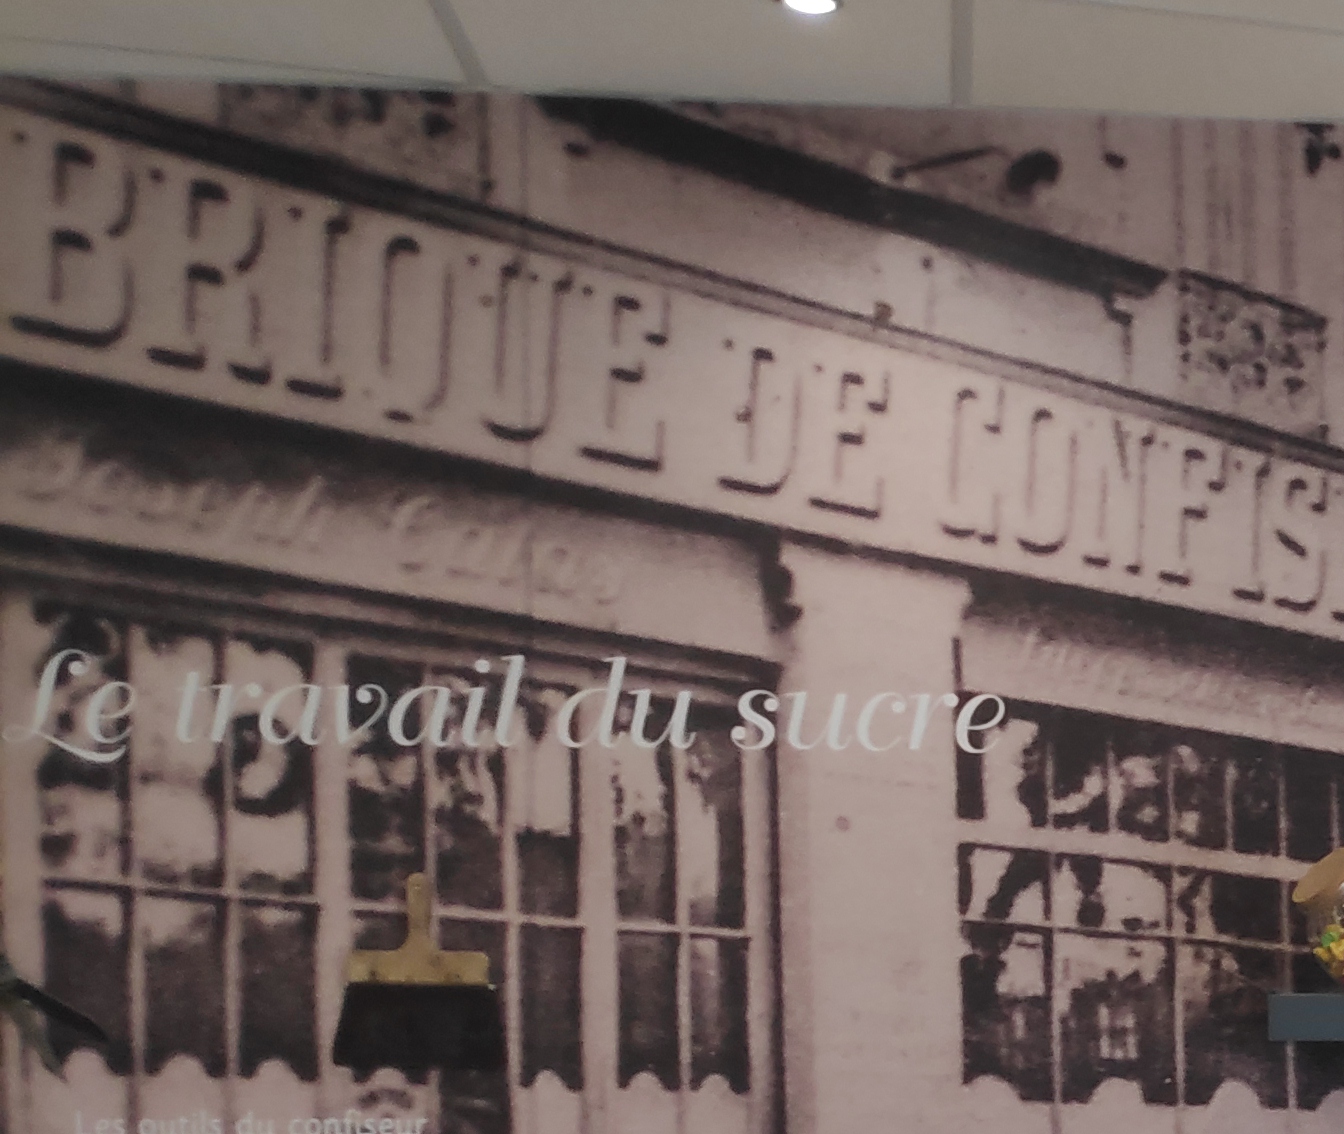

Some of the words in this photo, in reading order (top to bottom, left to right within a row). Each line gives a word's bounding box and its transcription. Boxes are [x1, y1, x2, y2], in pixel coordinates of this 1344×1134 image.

[714, 336, 890, 520] DE
[2, 648, 135, 763] Le
[174, 654, 526, 748] travail
[556, 656, 698, 750] du
[729, 688, 1006, 754] sucre
